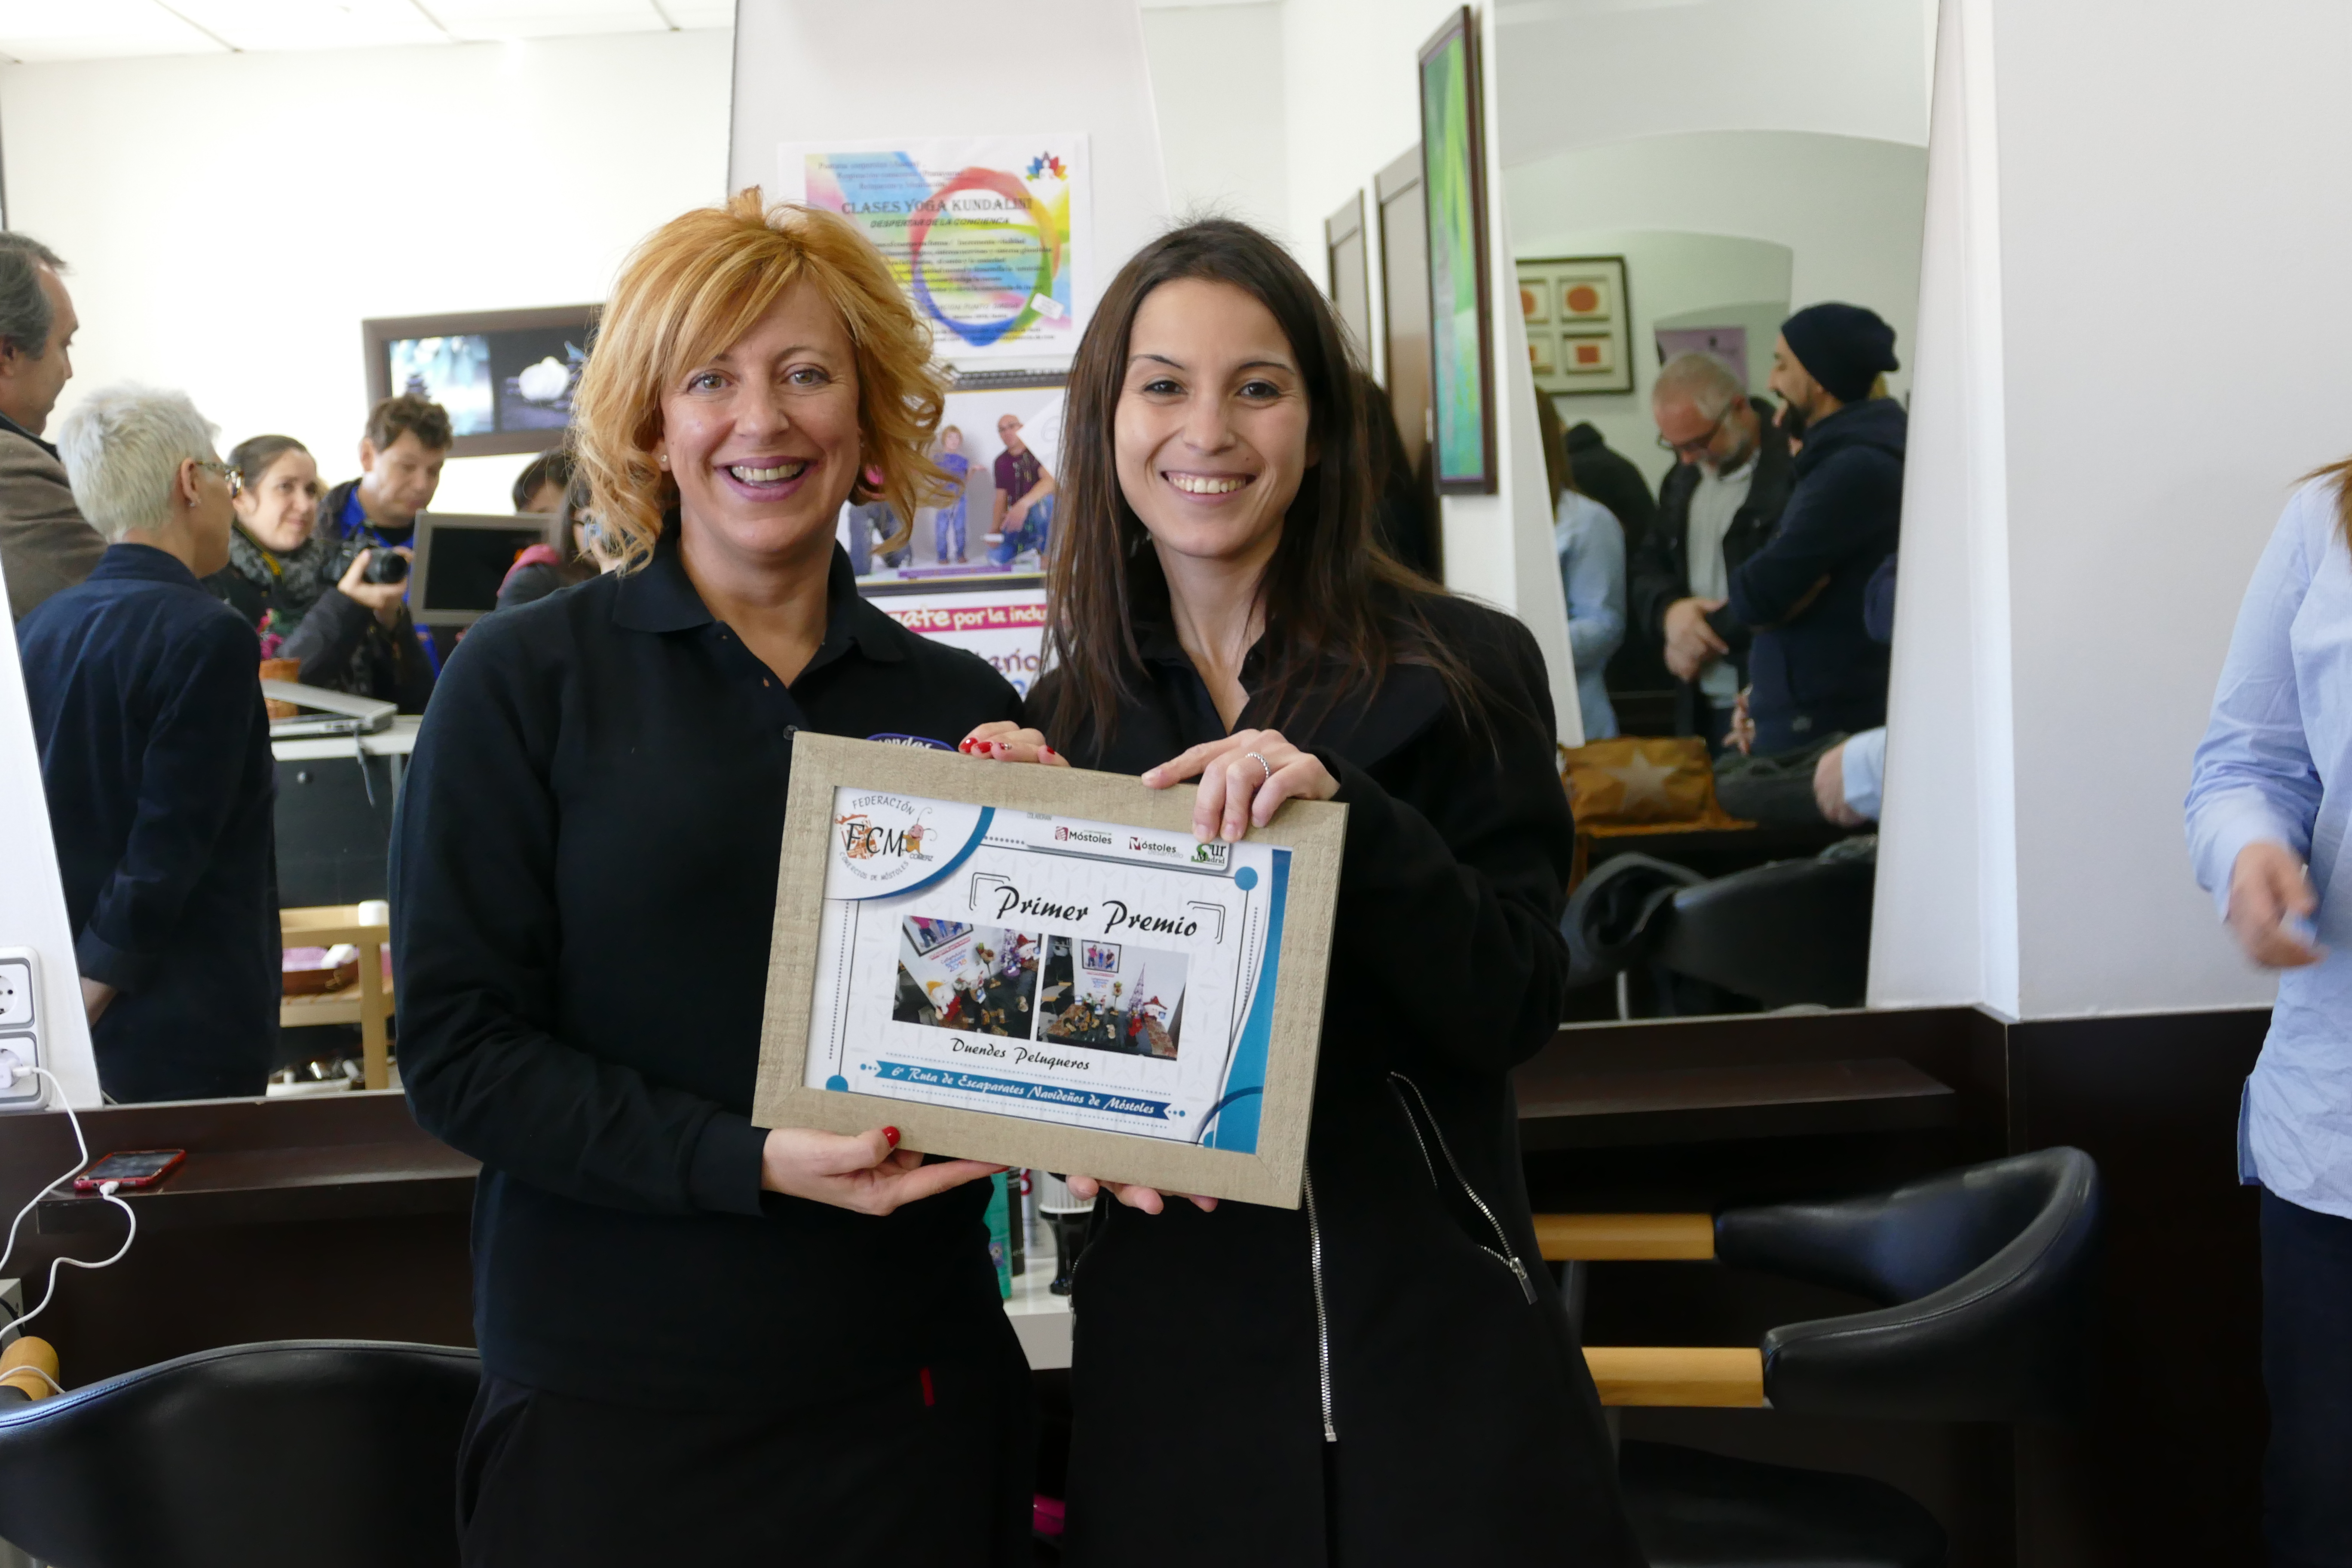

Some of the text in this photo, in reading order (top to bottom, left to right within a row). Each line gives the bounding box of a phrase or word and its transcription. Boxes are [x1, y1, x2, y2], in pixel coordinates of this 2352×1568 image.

[842, 197, 1032, 214] CLASES YOGA KUNDALINI
[953, 609, 985, 631] por
[988, 606, 1006, 623] la
[1010, 605, 1047, 622] inclu
[852, 795, 915, 815] FEDERACIÓN
[846, 823, 905, 857] FCM
[1069, 830, 1112, 845] Móstoles
[839, 851, 867, 879] COMERCIOS
[880, 860, 909, 881] MÓSTOLES
[1191, 843, 1227, 863] Sur
[1197, 851, 1225, 864] Madrid
[994, 885, 1197, 937] Primer Premio
[950, 1038, 1090, 1070] Duendes Peluqueros
[908, 1067, 938, 1083] Ruta
[941, 1072, 954, 1085] de
[958, 1075, 1025, 1095] Escaparates
[1027, 1086, 1084, 1104] Navideños
[1088, 1094, 1100, 1106] de
[1103, 1097, 1155, 1114] Móstoles
